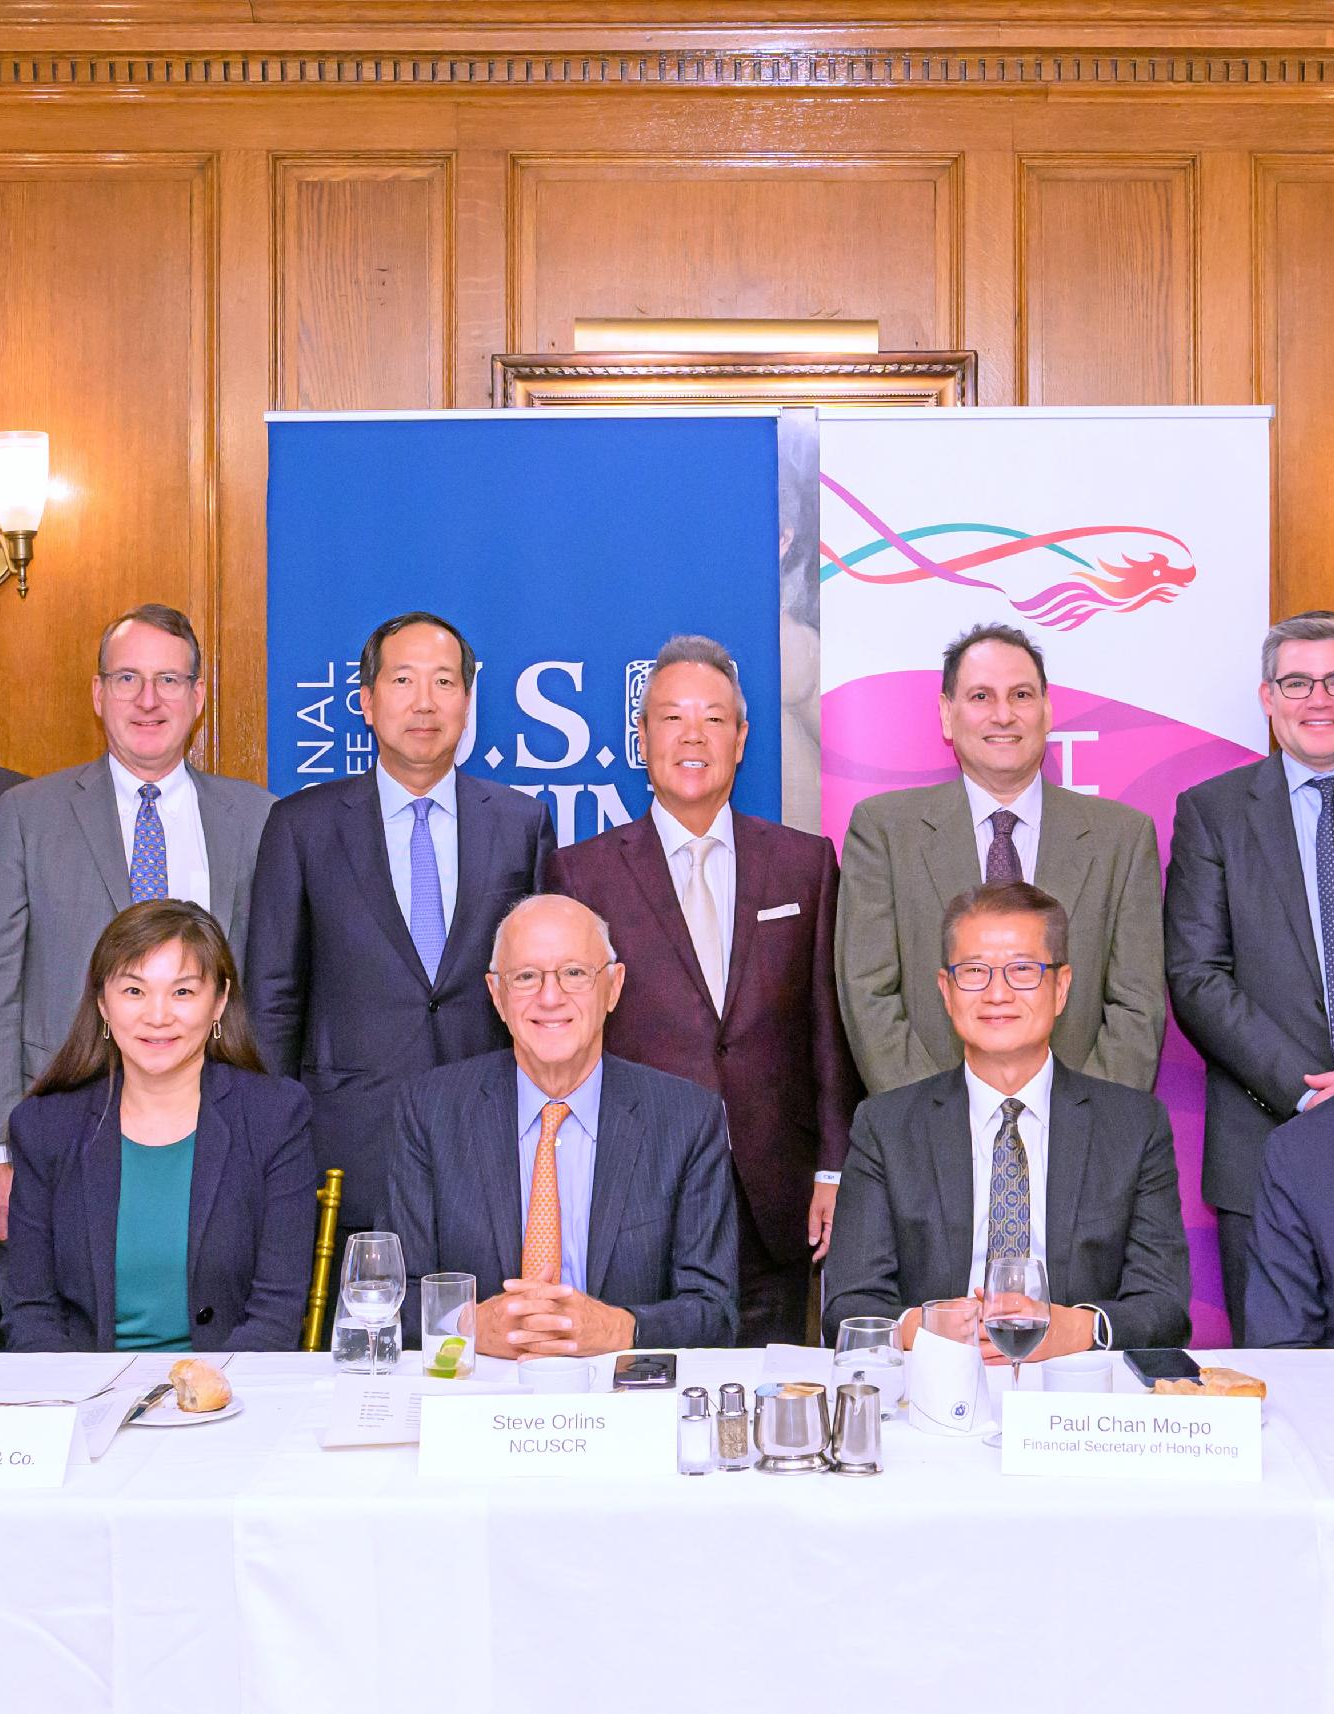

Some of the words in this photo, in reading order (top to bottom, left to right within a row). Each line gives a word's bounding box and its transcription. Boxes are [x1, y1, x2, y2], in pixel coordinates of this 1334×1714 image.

[492, 1414, 546, 1430] Steve
[552, 1413, 606, 1430] Orlins
[1049, 1415, 1091, 1432] Paul
[1097, 1416, 1146, 1433] Chan
[1153, 1417, 1212, 1438] Mo-po
[509, 1438, 587, 1453] NCUSCR
[1022, 1438, 1081, 1452] Financial
[1084, 1440, 1146, 1456] Secretary
[1150, 1442, 1163, 1454] of
[1166, 1442, 1201, 1458] Hong
[1205, 1443, 1240, 1459] Kong
[9, 1451, 36, 1465] Co.
